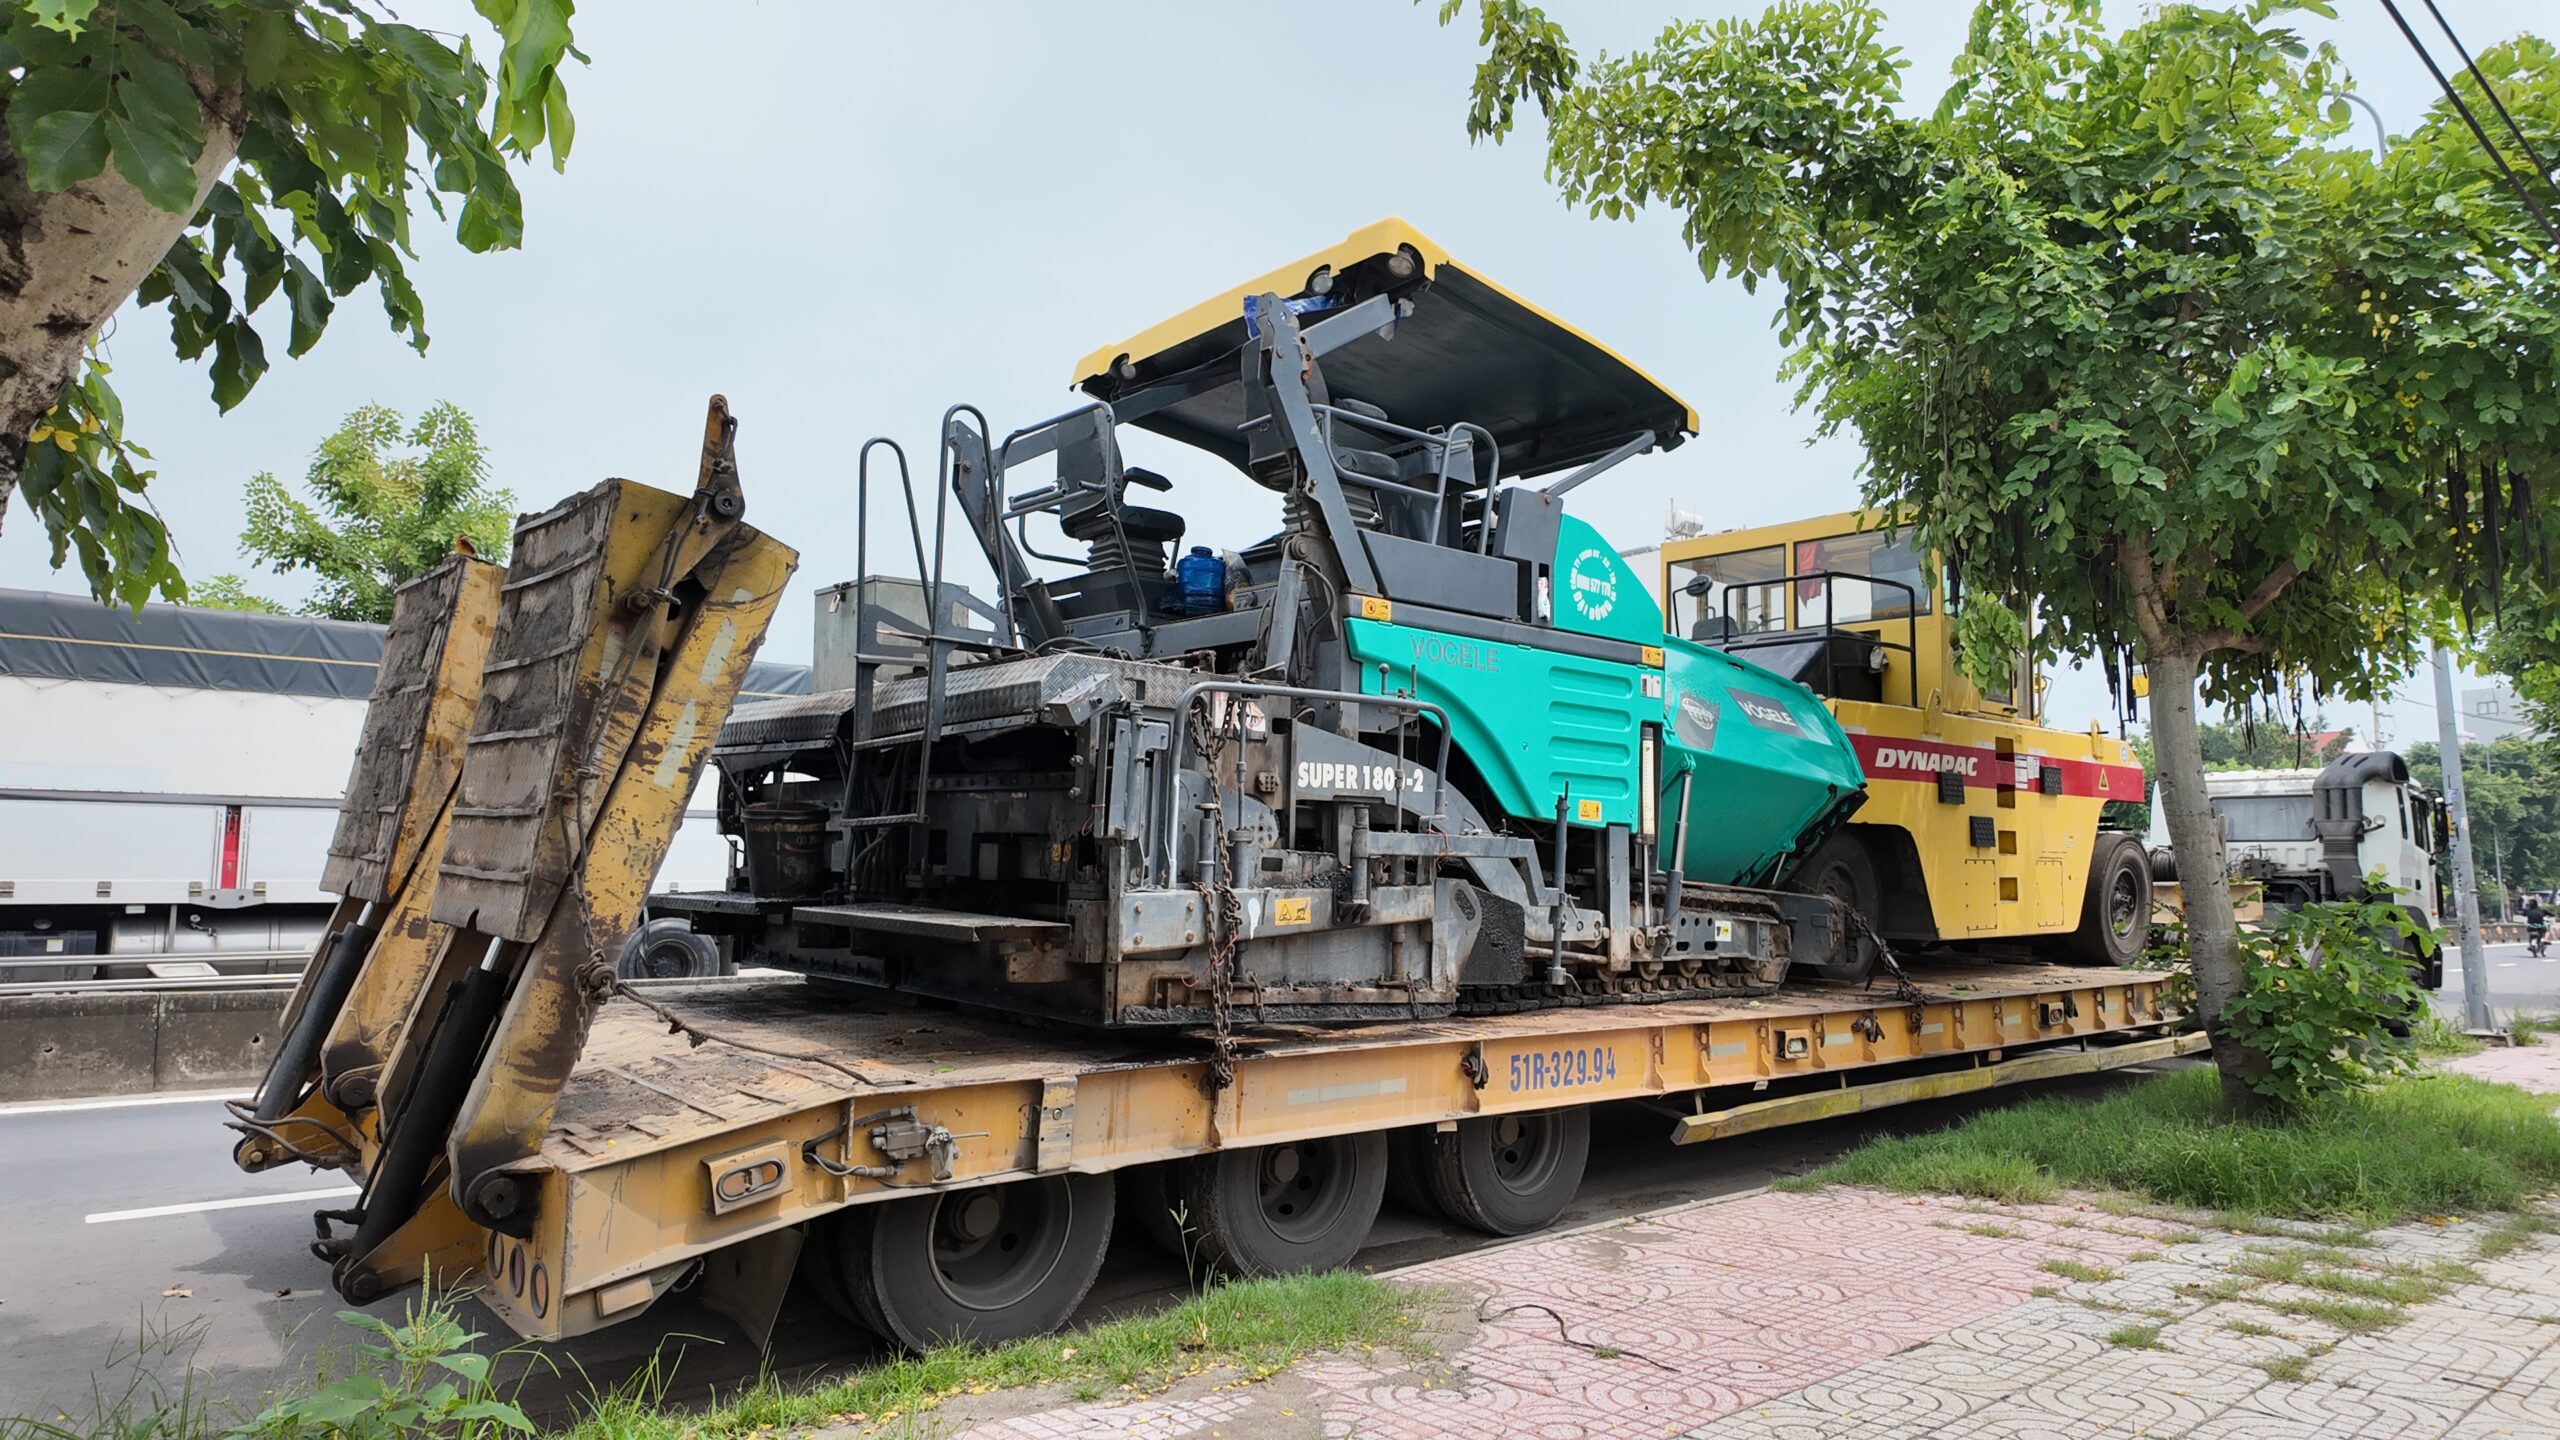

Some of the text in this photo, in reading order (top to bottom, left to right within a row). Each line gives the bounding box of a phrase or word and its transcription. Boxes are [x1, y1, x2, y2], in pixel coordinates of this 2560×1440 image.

[1410, 634, 1500, 673] VÖGELE
[1297, 761, 1359, 790] SUPER
[1875, 747, 1979, 777] DYNAPAC
[1510, 1046, 1616, 1093] 51R-329.94
